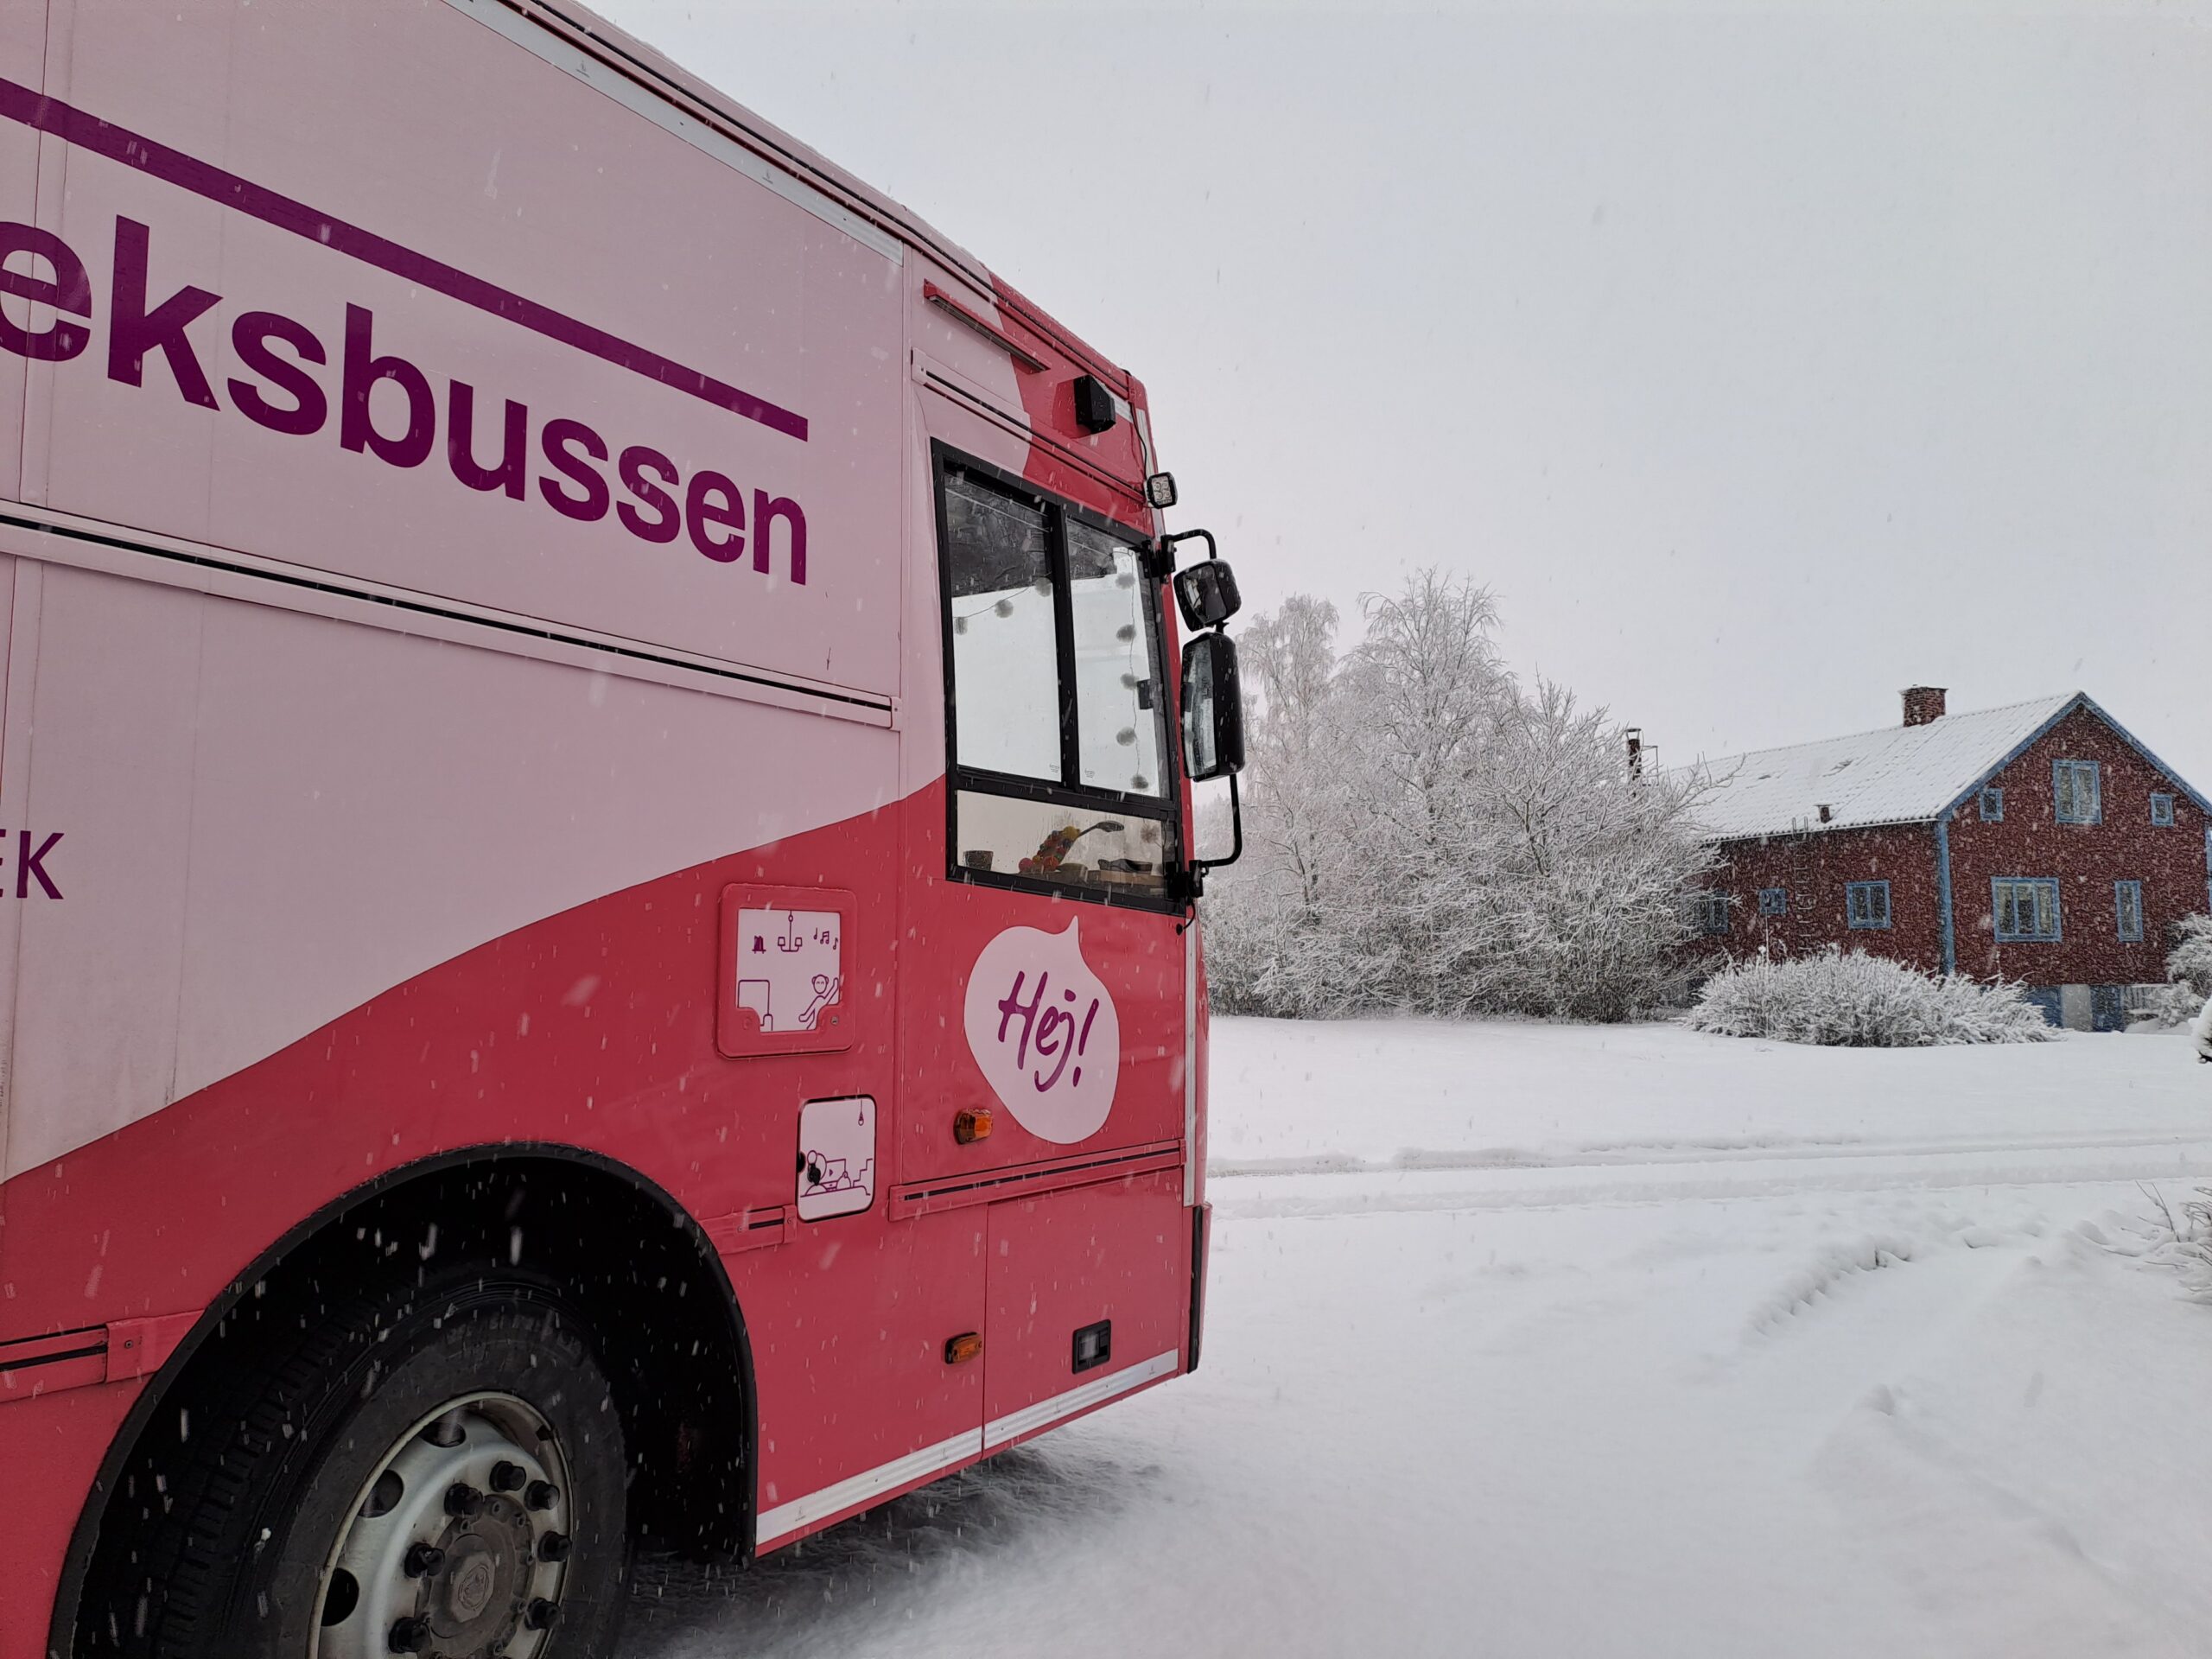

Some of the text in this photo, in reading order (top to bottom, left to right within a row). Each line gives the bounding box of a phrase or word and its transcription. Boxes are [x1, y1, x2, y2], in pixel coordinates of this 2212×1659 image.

[0, 214, 807, 586] eksbussen
[0, 829, 65, 899] K
[998, 970, 1099, 1092] Hej!
